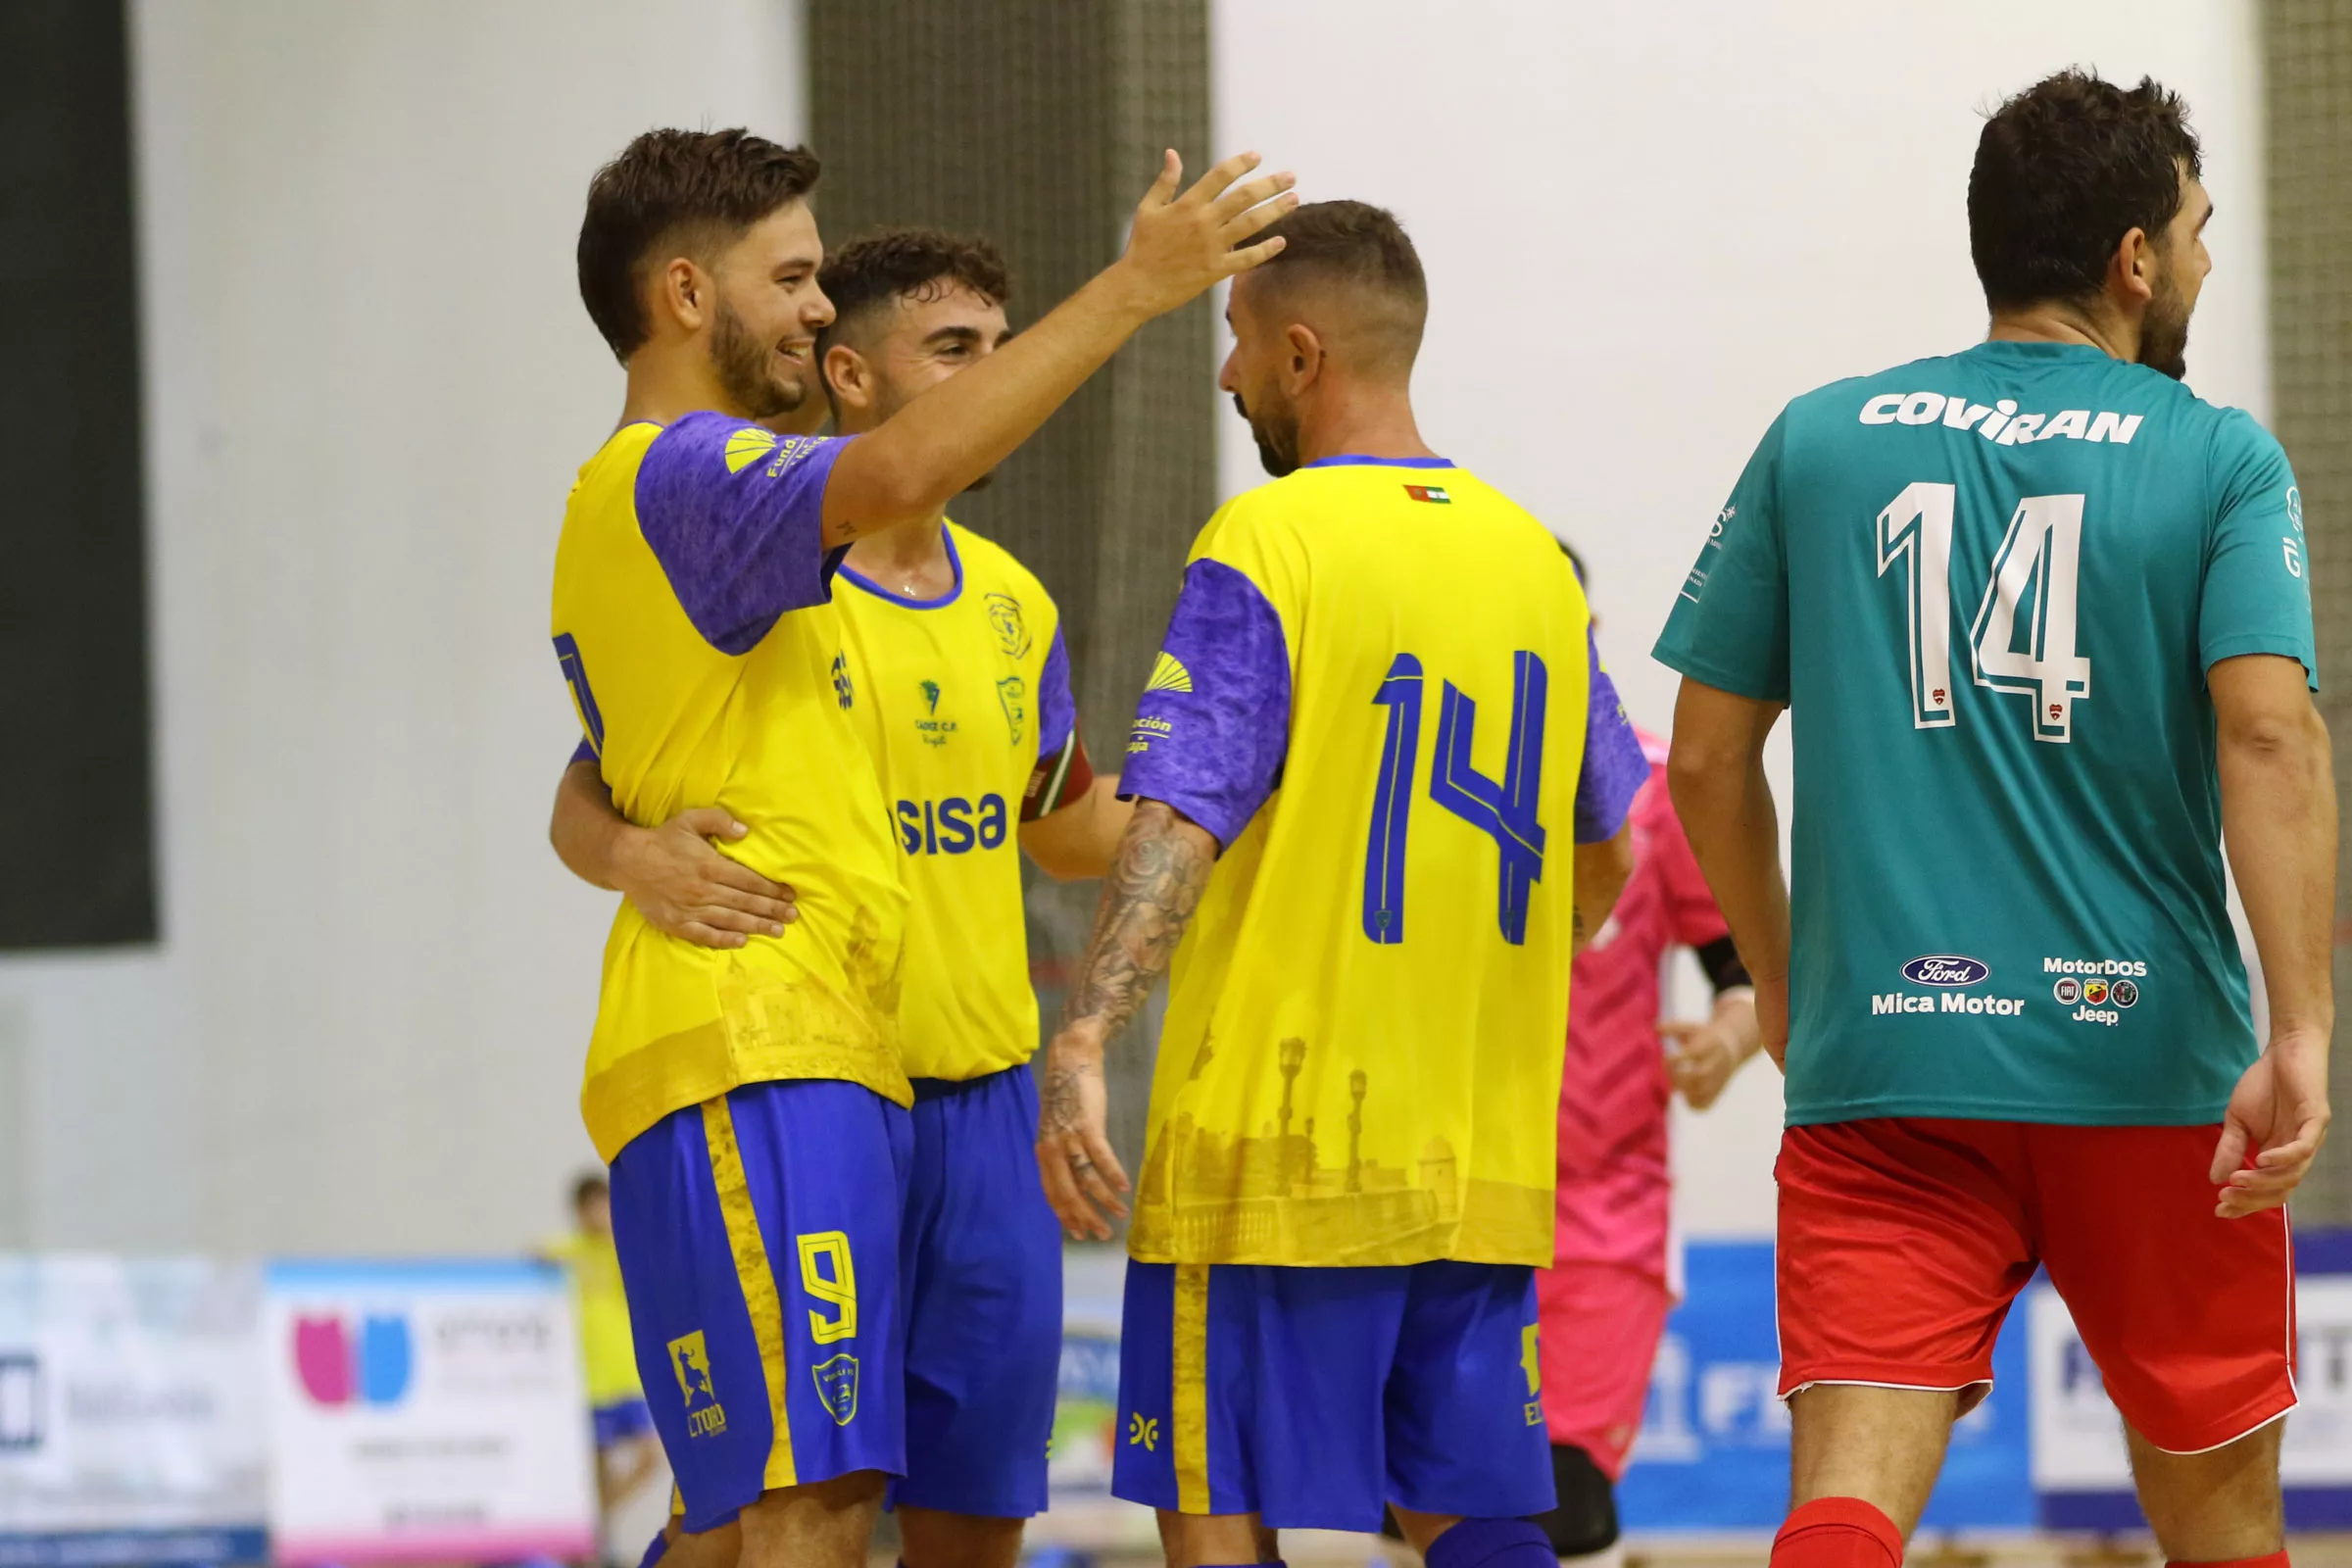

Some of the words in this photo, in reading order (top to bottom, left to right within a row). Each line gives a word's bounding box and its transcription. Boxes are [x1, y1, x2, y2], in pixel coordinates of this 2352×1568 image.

[1876, 481, 2091, 744] 14
[1361, 650, 1548, 947] 14
[1918, 957, 1972, 983] Ford
[2043, 956, 2148, 978] MotorDOS
[1871, 992, 1936, 1016] Mica
[1941, 992, 2026, 1016] Motor
[2060, 985, 2075, 998] FIAT
[2072, 1004, 2119, 1026] Jeep
[796, 1230, 858, 1346] 9
